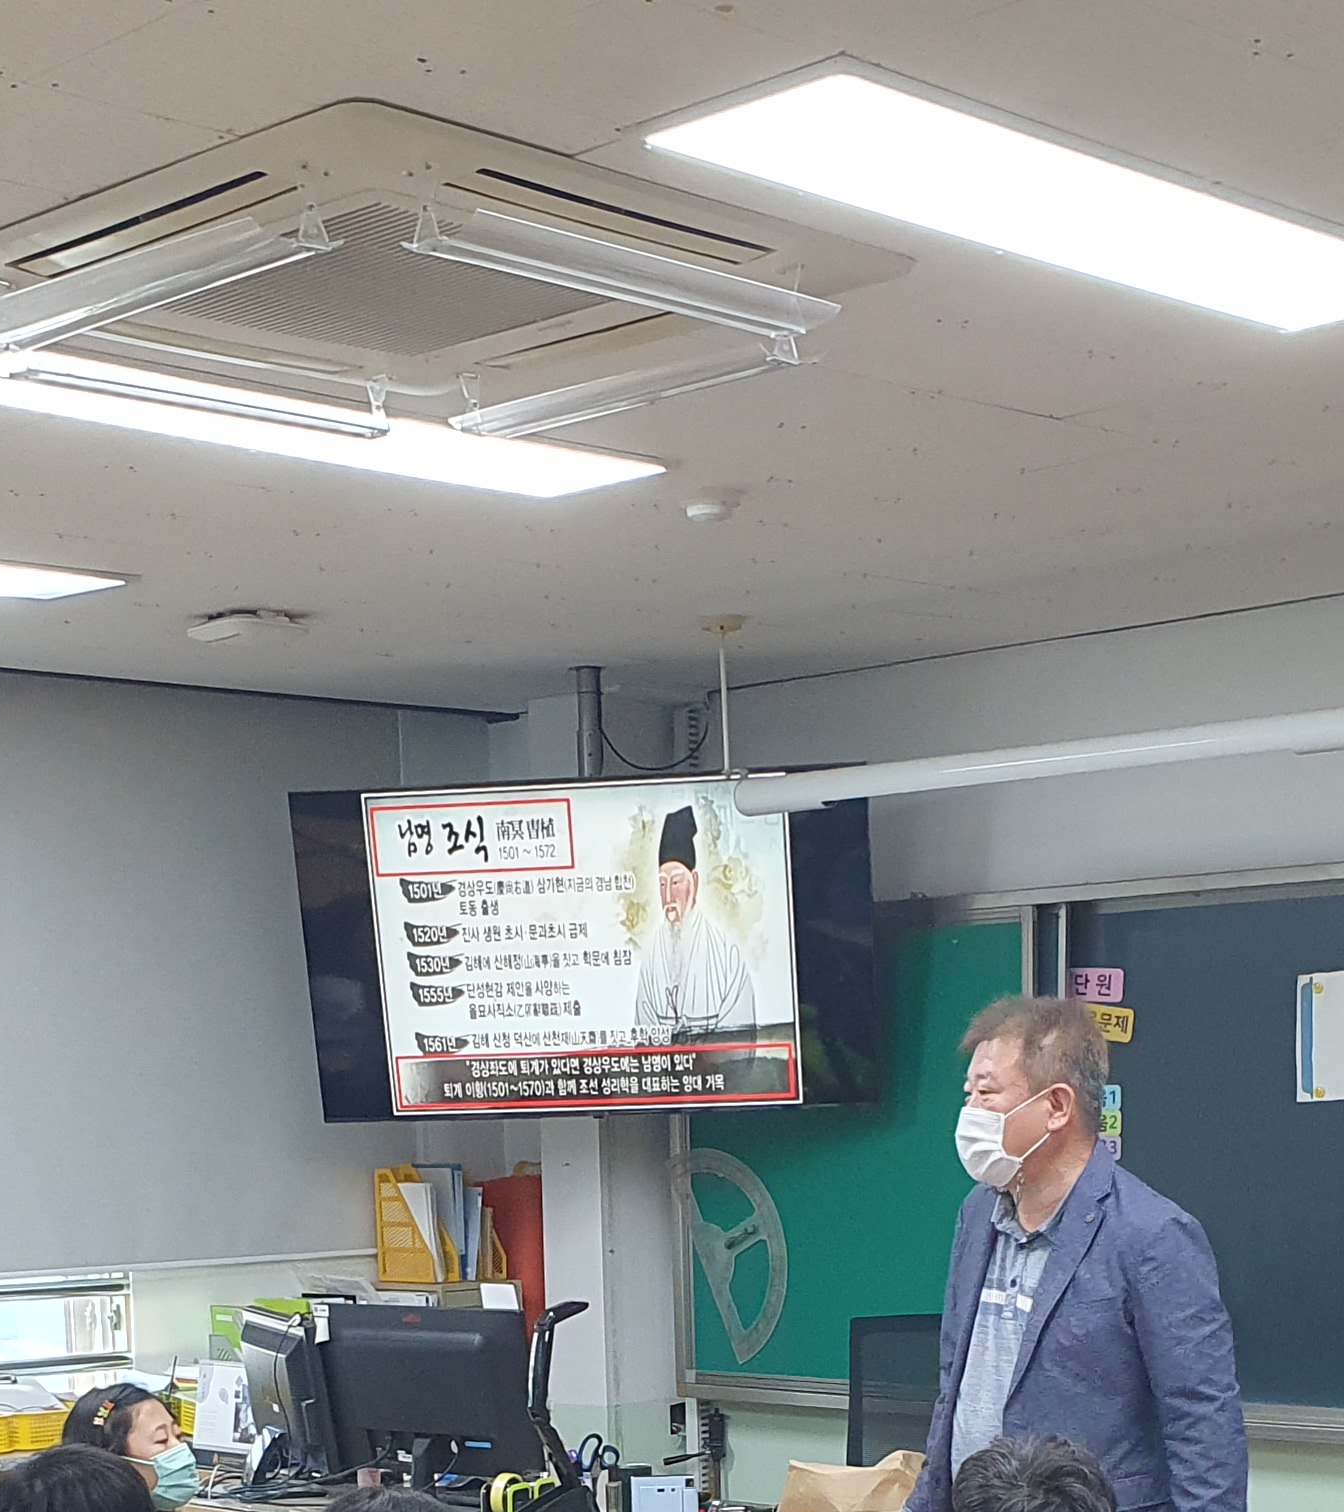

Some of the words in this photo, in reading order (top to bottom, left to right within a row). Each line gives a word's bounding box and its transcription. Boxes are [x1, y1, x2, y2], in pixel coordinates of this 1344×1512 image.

[398, 819, 433, 857] 남명
[442, 815, 488, 862] 조식
[498, 846, 519, 860] 1501
[534, 844, 556, 858] 1572
[408, 882, 442, 899] 1501년
[595, 876, 613, 892] 경남
[459, 901, 477, 917] 토동
[481, 899, 500, 916] 출생
[412, 925, 448, 942] 1520년
[461, 927, 480, 943] 진사
[483, 925, 502, 943] 생원
[568, 922, 587, 939] 급제
[415, 957, 451, 973] 1530년
[464, 955, 491, 971] 김해에
[563, 953, 579, 967] 짓고
[418, 986, 453, 1003] 1555년
[466, 982, 503, 998] 단성현감
[473, 1033, 489, 1048] 김해
[520, 1058, 548, 1075] 퇴계가
[551, 1056, 580, 1075] 있다면
[582, 1054, 640, 1074] 경상우도에는
[642, 1053, 671, 1072] 남명이
[443, 1081, 462, 1098] 퇴계
[557, 1078, 577, 1096] 함께
[579, 1078, 599, 1095] 조선
[601, 1076, 638, 1094] 성리학을
[642, 1075, 680, 1092] 대표하는
[705, 1073, 725, 1091] 거목
